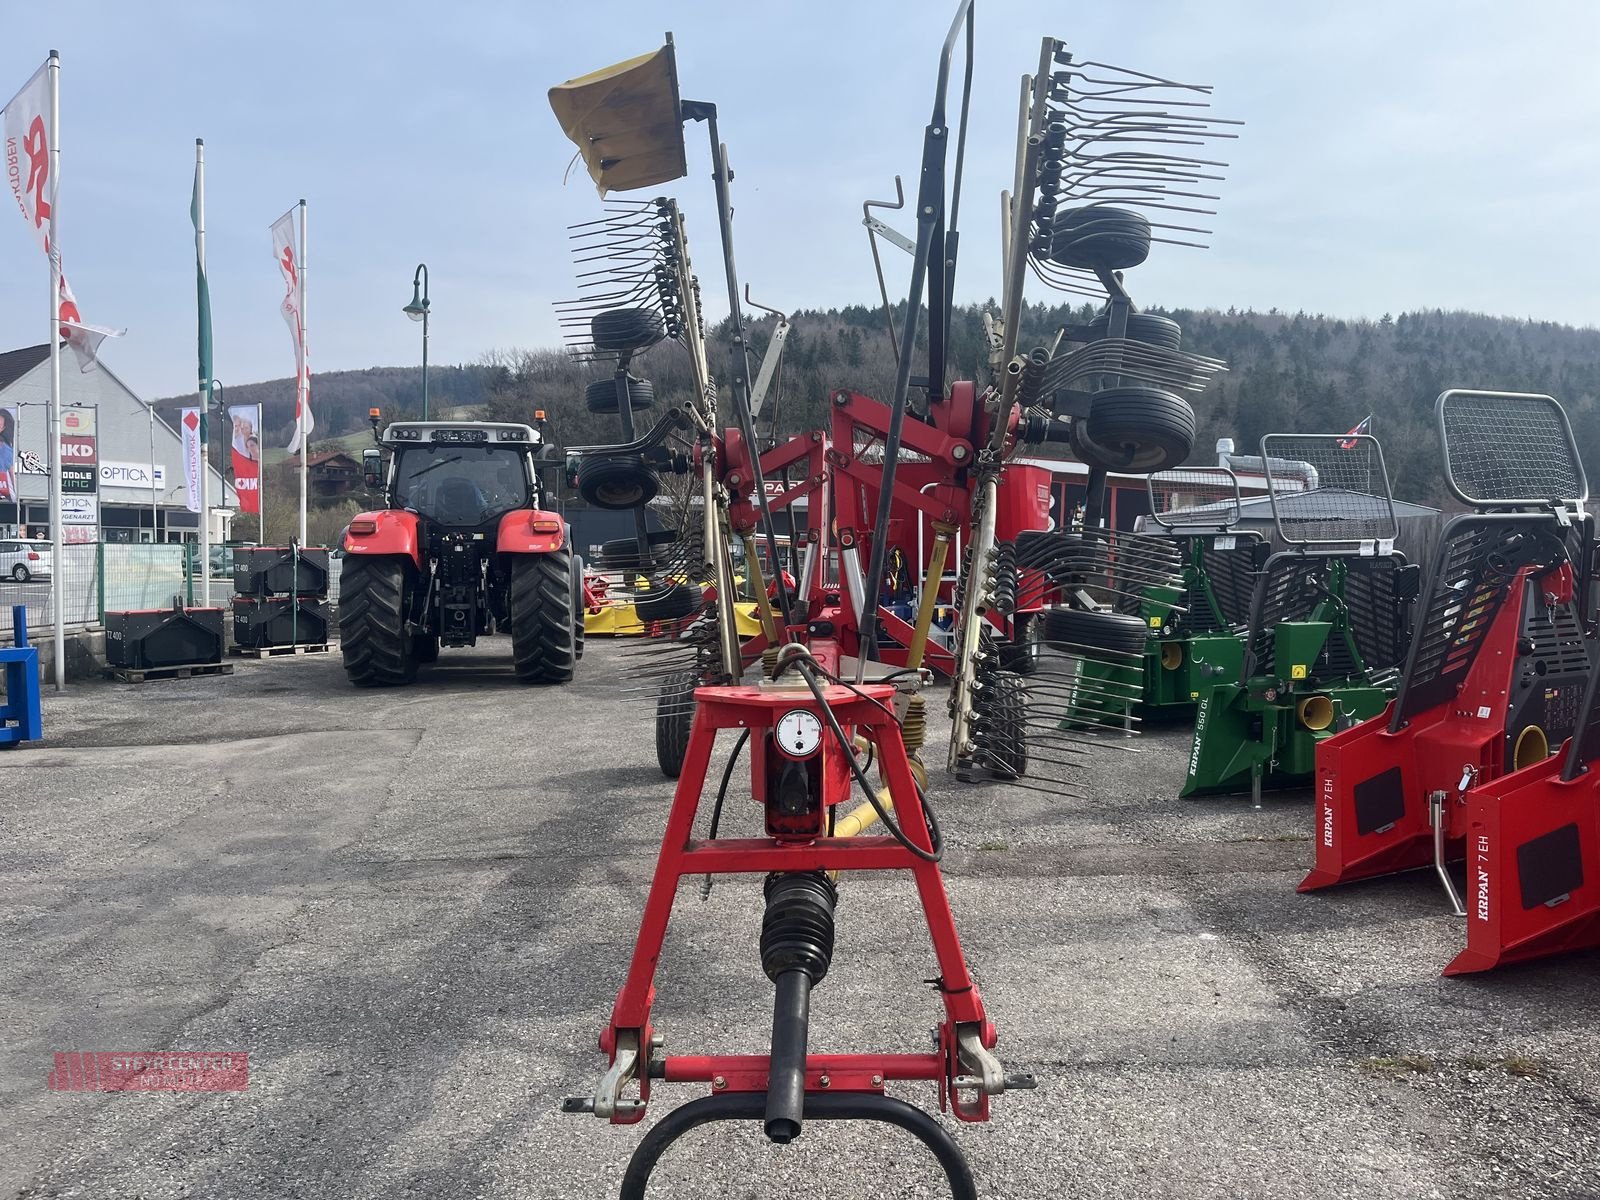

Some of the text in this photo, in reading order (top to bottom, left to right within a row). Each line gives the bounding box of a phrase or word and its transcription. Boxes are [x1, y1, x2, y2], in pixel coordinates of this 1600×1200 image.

[62, 471, 92, 480] OODLE
[101, 467, 149, 481] OPTICA
[240, 564, 249, 572] 400
[240, 616, 248, 624] 400
[107, 631, 122, 640] TZ 400
[1201, 697, 1209, 709] GL
[1197, 711, 1206, 731] 550
[1324, 779, 1333, 792] EH
[1478, 835, 1489, 852] EH
